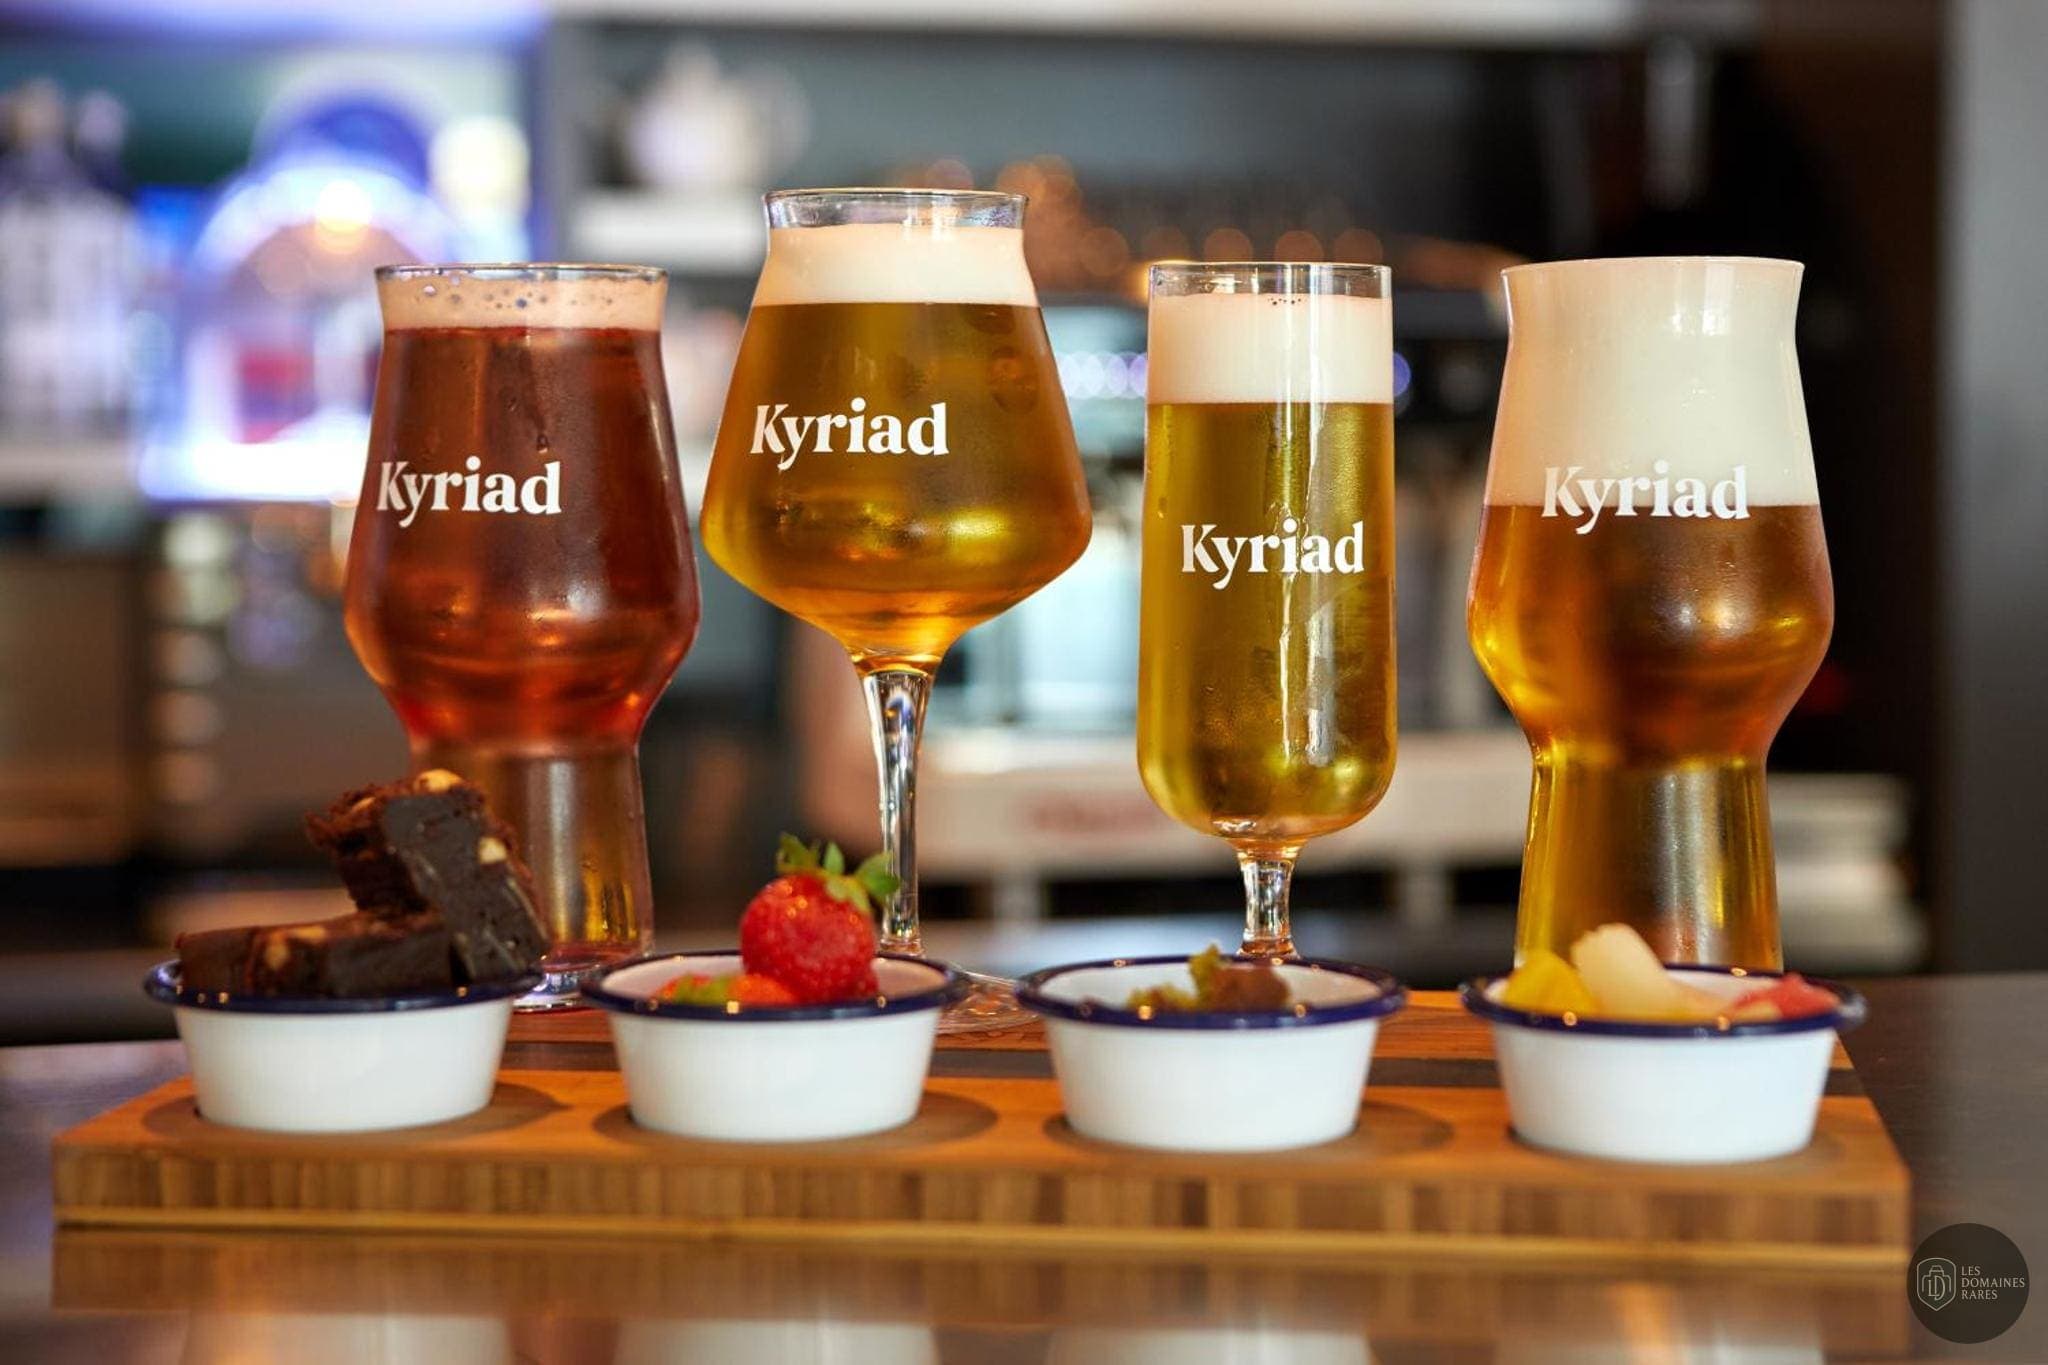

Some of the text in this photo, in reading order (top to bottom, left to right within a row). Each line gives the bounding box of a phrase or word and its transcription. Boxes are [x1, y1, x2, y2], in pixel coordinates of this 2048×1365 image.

[750, 397, 950, 471] Kyriad
[376, 455, 562, 528] Kyriad
[1541, 459, 1751, 535] Kyriad
[1181, 517, 1365, 590] Kyriad
